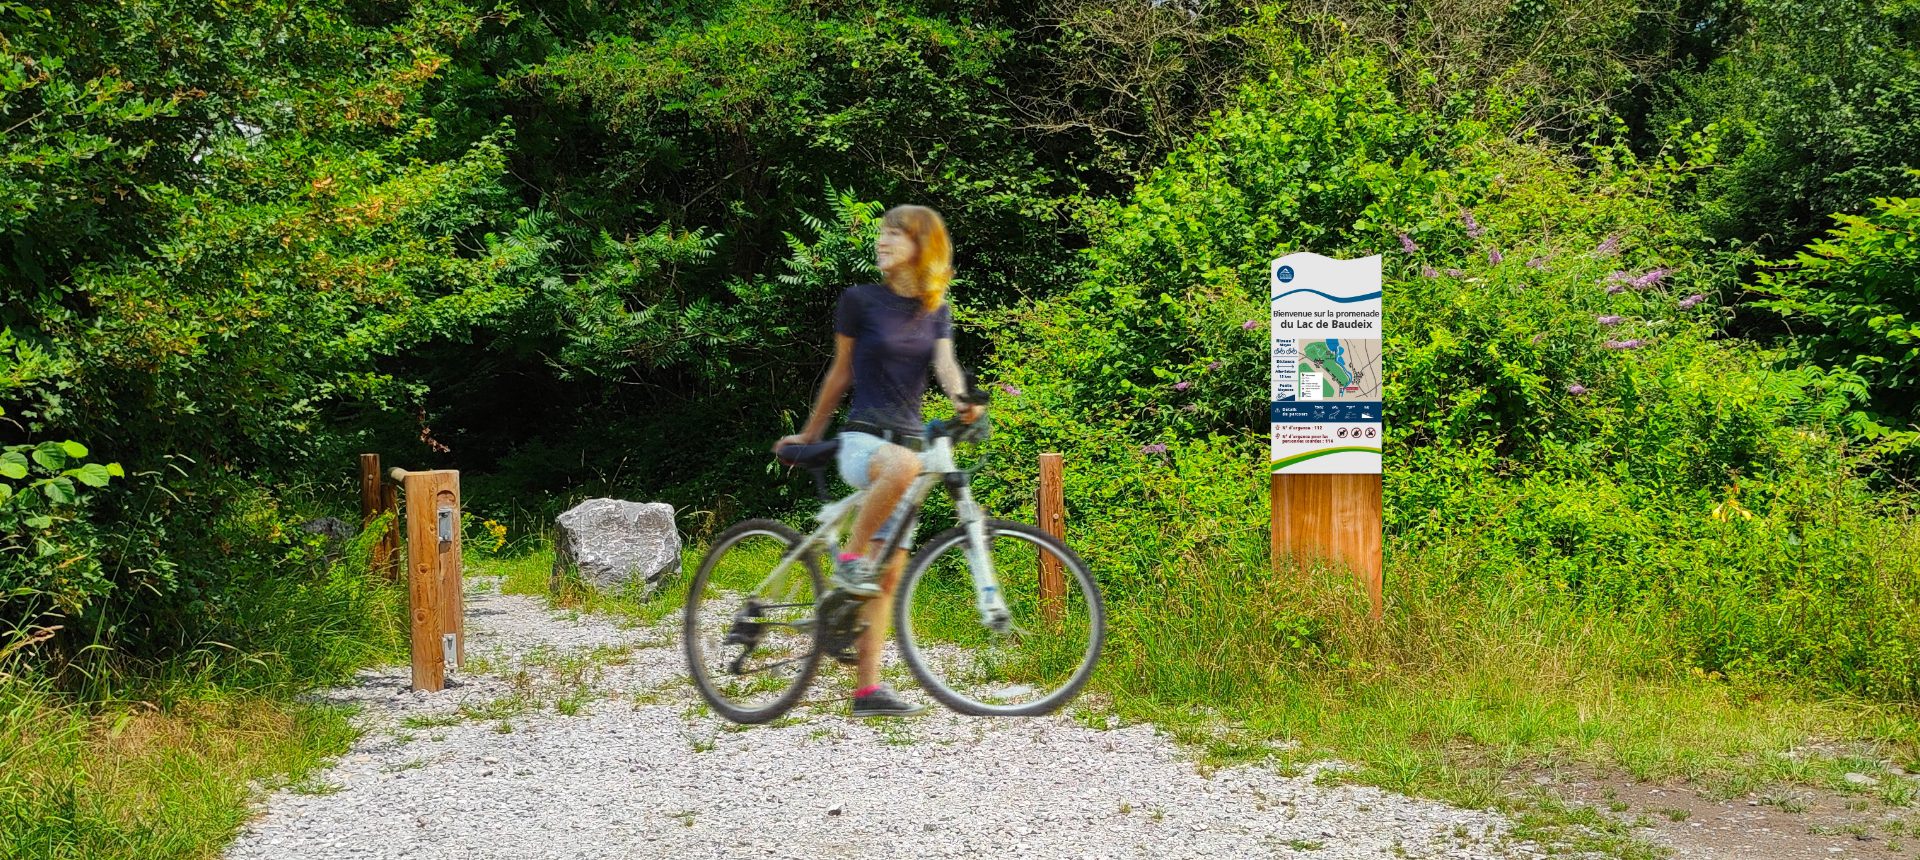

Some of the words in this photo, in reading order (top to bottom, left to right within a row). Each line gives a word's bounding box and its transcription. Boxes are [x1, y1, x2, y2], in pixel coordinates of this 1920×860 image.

[1273, 309, 1312, 318] Bienvenue
[1328, 310, 1334, 318] la
[1336, 310, 1380, 319] promenade
[1280, 320, 1294, 328] du
[1296, 320, 1314, 328] Lac
[1316, 320, 1328, 328] de
[1332, 320, 1372, 328] Baudeix
